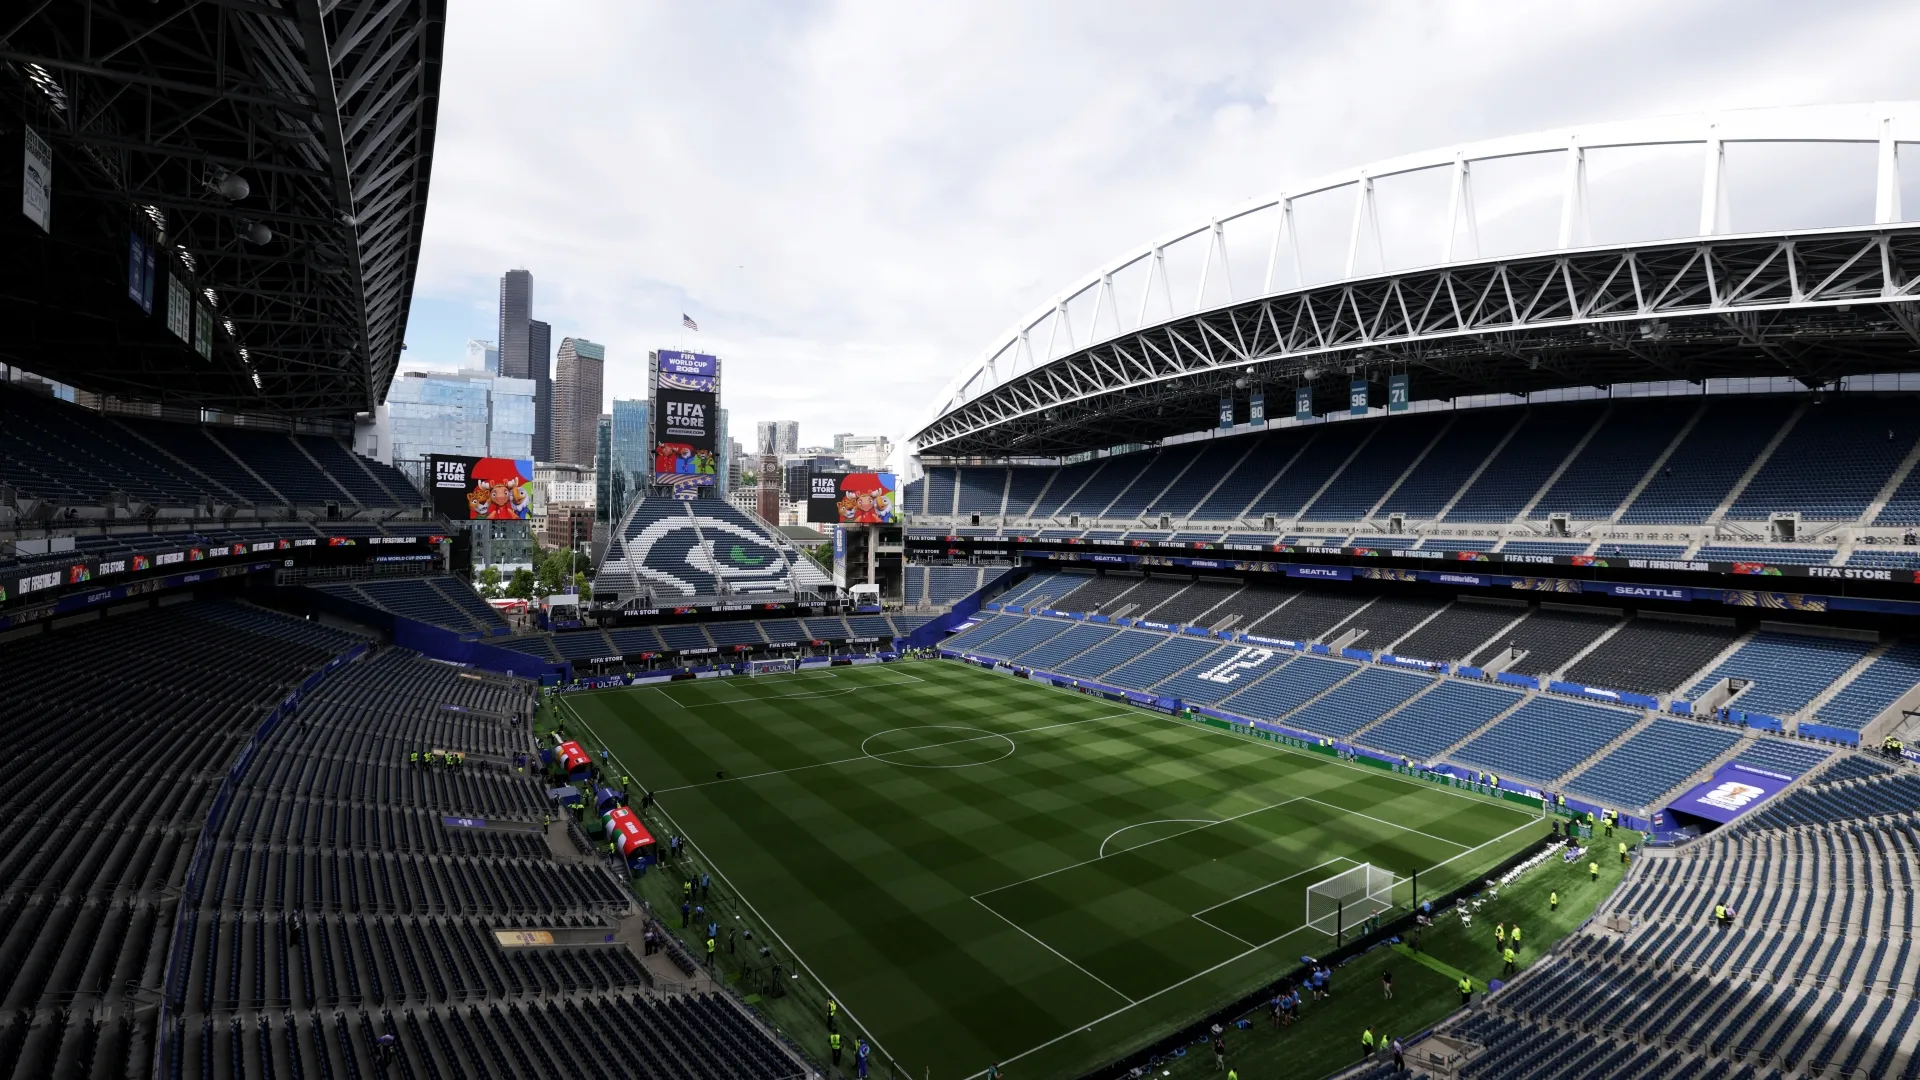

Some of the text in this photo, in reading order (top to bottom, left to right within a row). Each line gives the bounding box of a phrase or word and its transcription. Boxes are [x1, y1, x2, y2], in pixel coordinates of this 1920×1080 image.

[1352, 393, 1366, 407] 96
[1392, 389, 1405, 403] 71
[667, 401, 704, 417] FIFA
[1251, 406, 1263, 418] 80
[1298, 400, 1309, 413] 12
[667, 416, 704, 427] STORE
[1221, 410, 1232, 422] 45
[436, 461, 465, 474] FIFA
[436, 472, 465, 481] STORE
[812, 478, 835, 487] FIFA
[1504, 554, 1554, 564] FIFA STORE
[1628, 559, 1709, 571] VISIT FIFASTORE.COM
[99, 560, 125, 576] FIFA STORE
[1299, 568, 1338, 576] SEATTLE
[1808, 567, 1892, 580] FIFA STORE
[1440, 574, 1480, 584] #FIFAWorldCup
[88, 591, 111, 603] SEATTLE
[1615, 586, 1682, 598] SEATTLE
[1144, 621, 1169, 629] SEATTLE
[1395, 656, 1434, 667] SEATTLE
[768, 664, 791, 672] ULTRA
[597, 680, 624, 688] ULTRA
[1085, 690, 1104, 699] ULTRA
